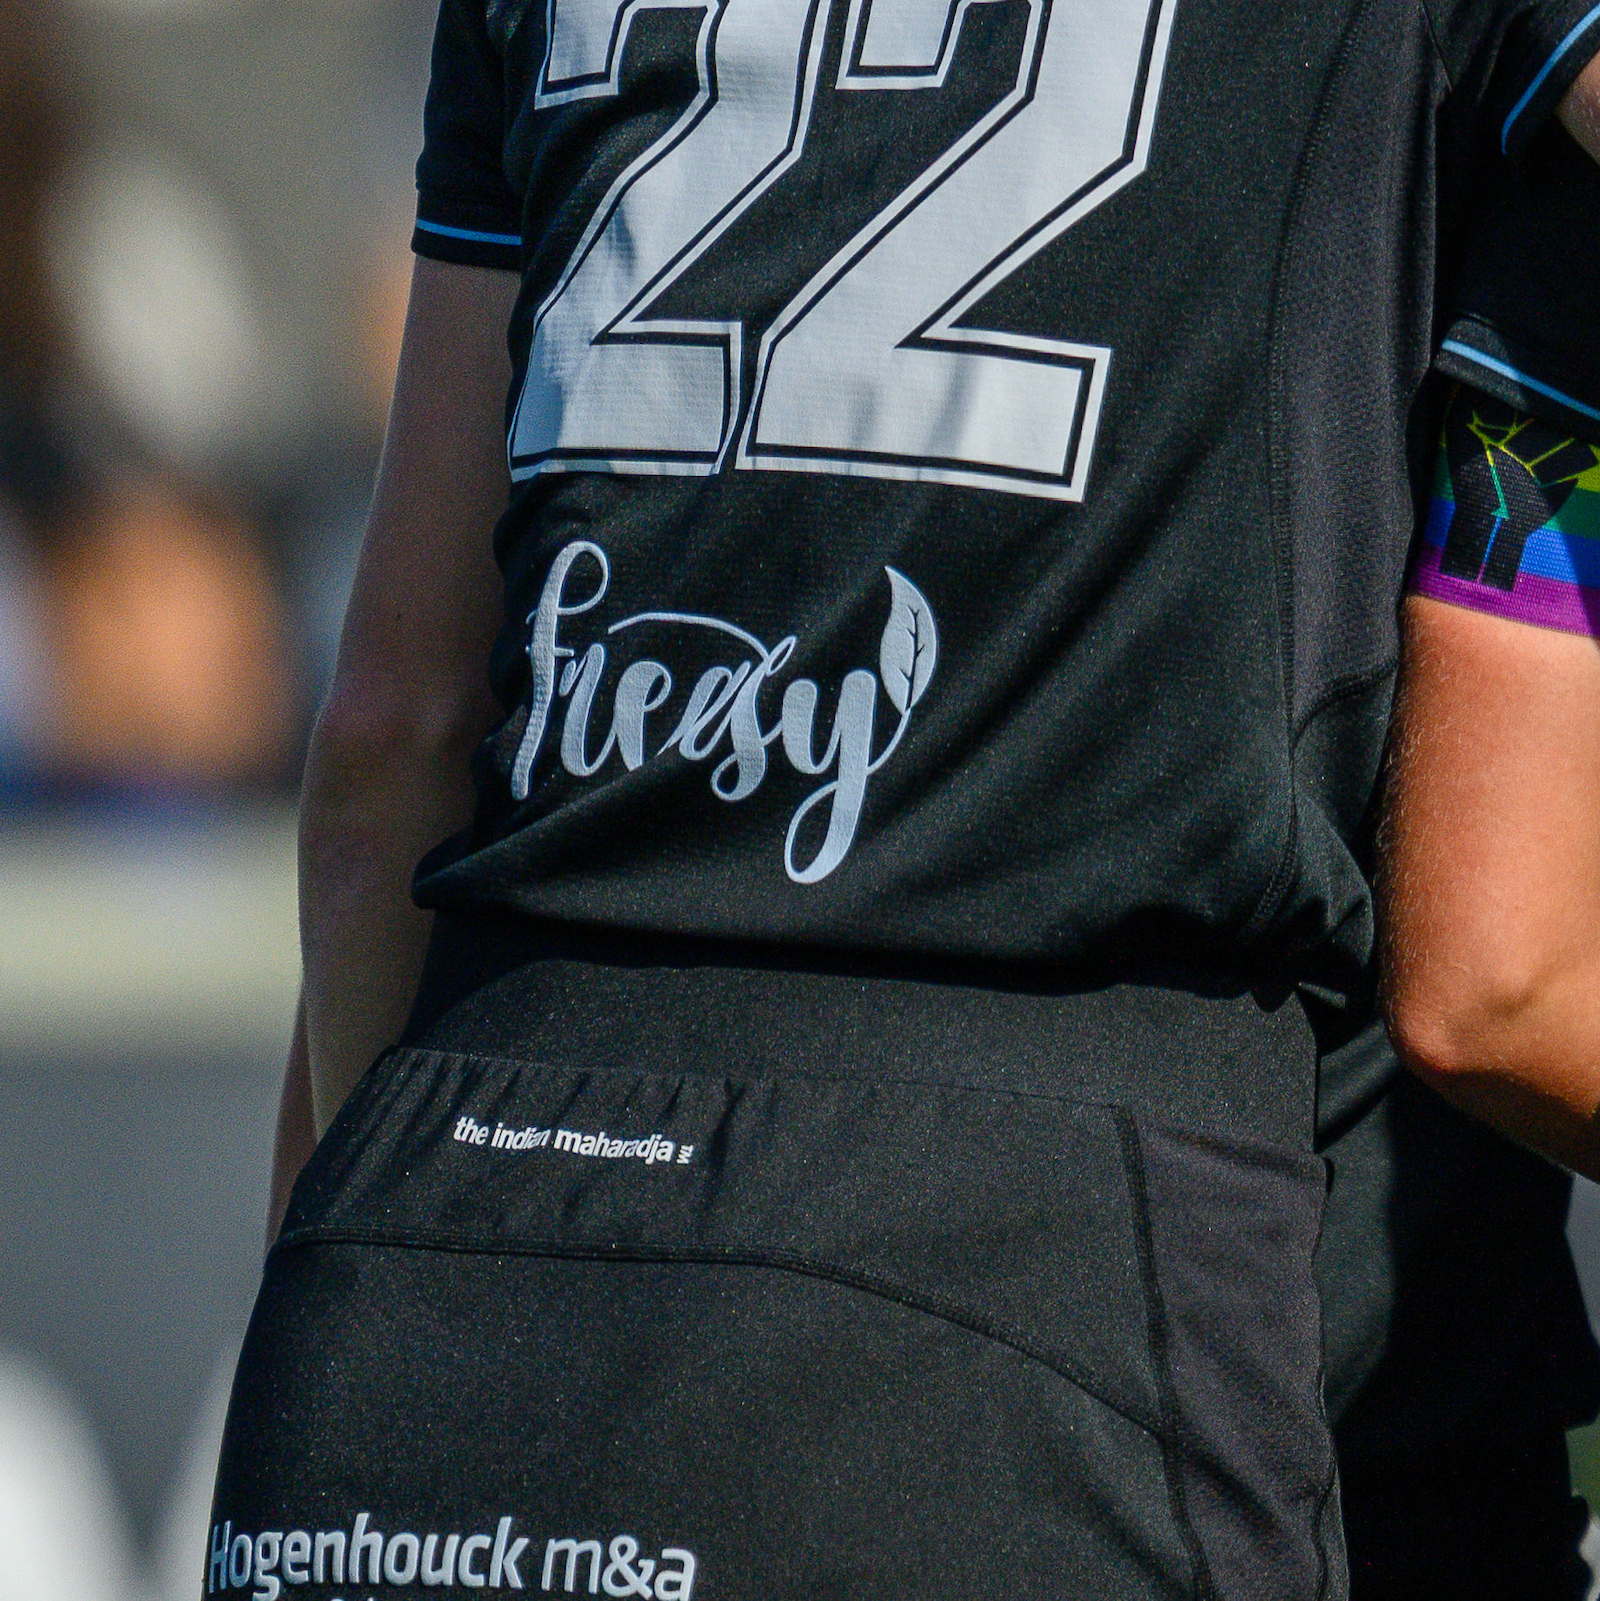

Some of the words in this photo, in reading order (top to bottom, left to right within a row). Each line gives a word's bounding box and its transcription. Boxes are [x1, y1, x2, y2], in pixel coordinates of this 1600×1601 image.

[511, 539, 938, 885] freasy
[453, 1116, 490, 1146] the
[491, 1122, 551, 1150] indian
[554, 1129, 675, 1166] maharadja
[208, 1512, 530, 1600] Hogenhouck
[542, 1534, 697, 1601] m&a
